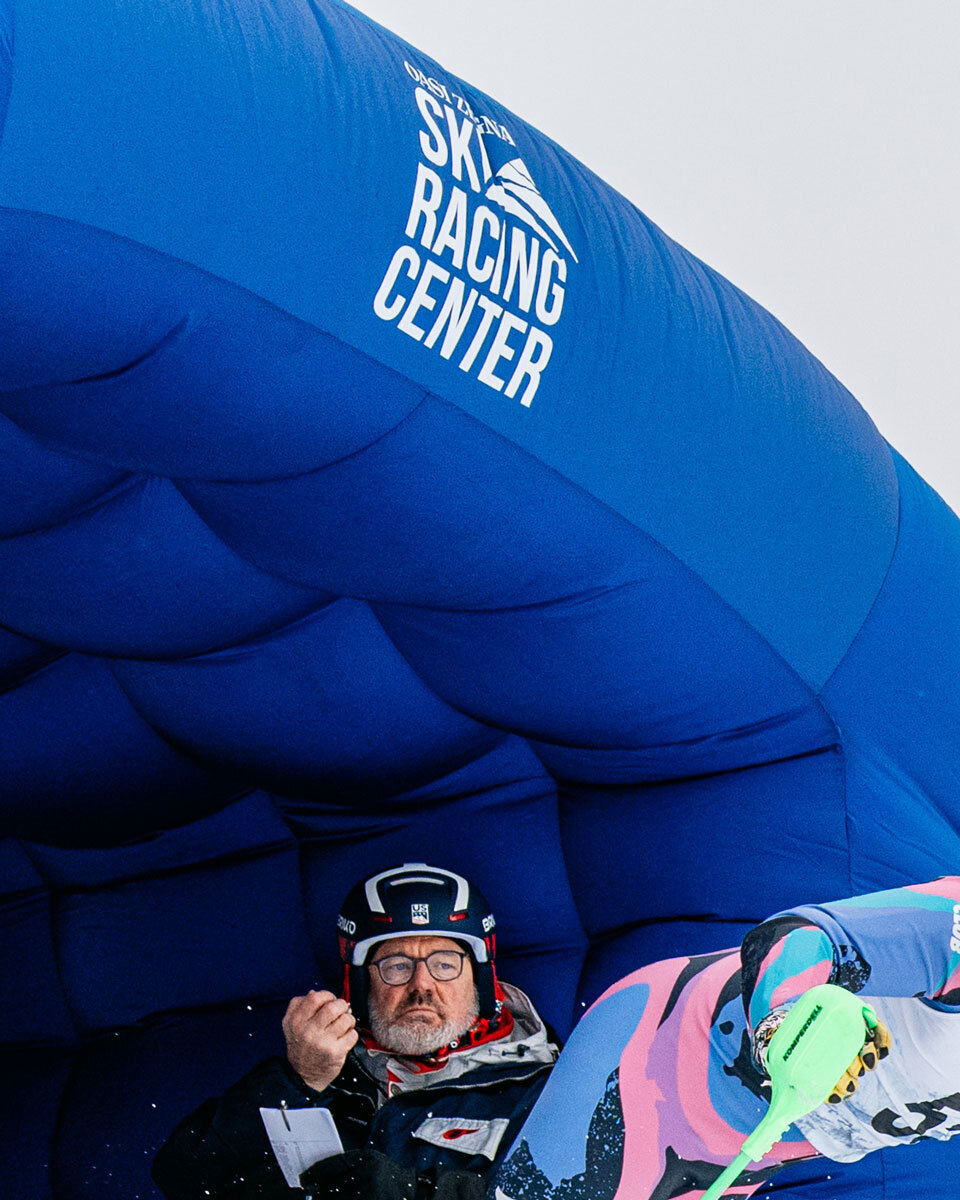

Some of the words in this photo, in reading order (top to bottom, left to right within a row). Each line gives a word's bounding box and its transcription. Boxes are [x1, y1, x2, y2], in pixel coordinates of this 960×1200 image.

[404, 60, 453, 104] OASI
[451, 92, 517, 147] ZNA
[413, 86, 493, 193] SKI
[404, 161, 567, 326] RACING
[373, 244, 554, 408] CENTER
[412, 904, 428, 912] US
[782, 1004, 823, 1062] KOMPERDELL
